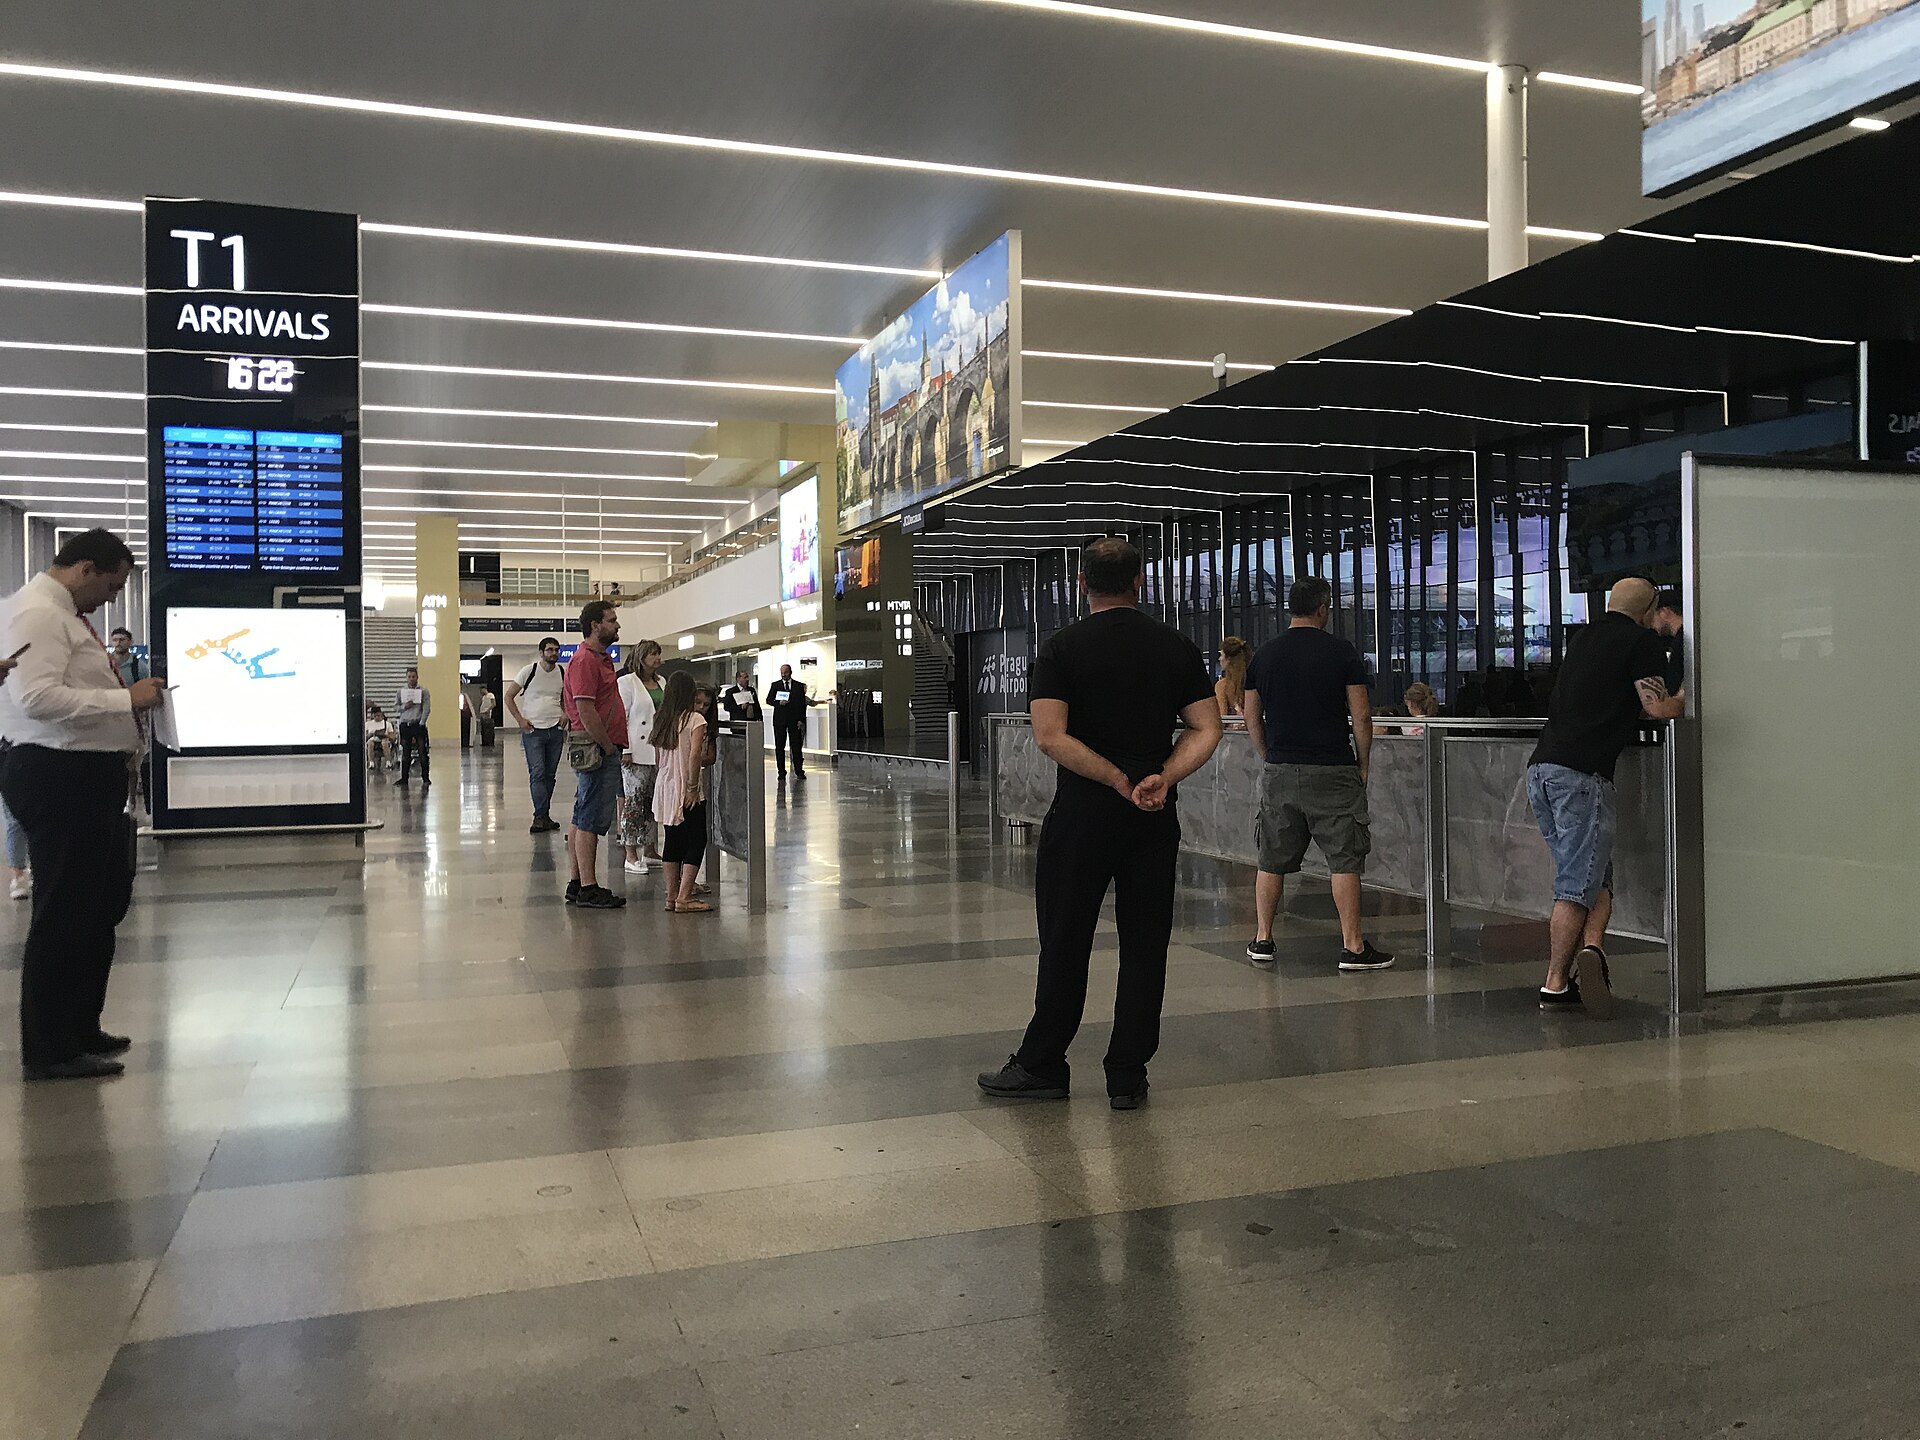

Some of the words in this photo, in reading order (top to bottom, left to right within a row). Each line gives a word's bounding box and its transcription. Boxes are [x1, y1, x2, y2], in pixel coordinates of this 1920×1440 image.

[170, 229, 245, 291] T1
[177, 303, 331, 341] ARRIVALS
[422, 595, 447, 608] ATM
